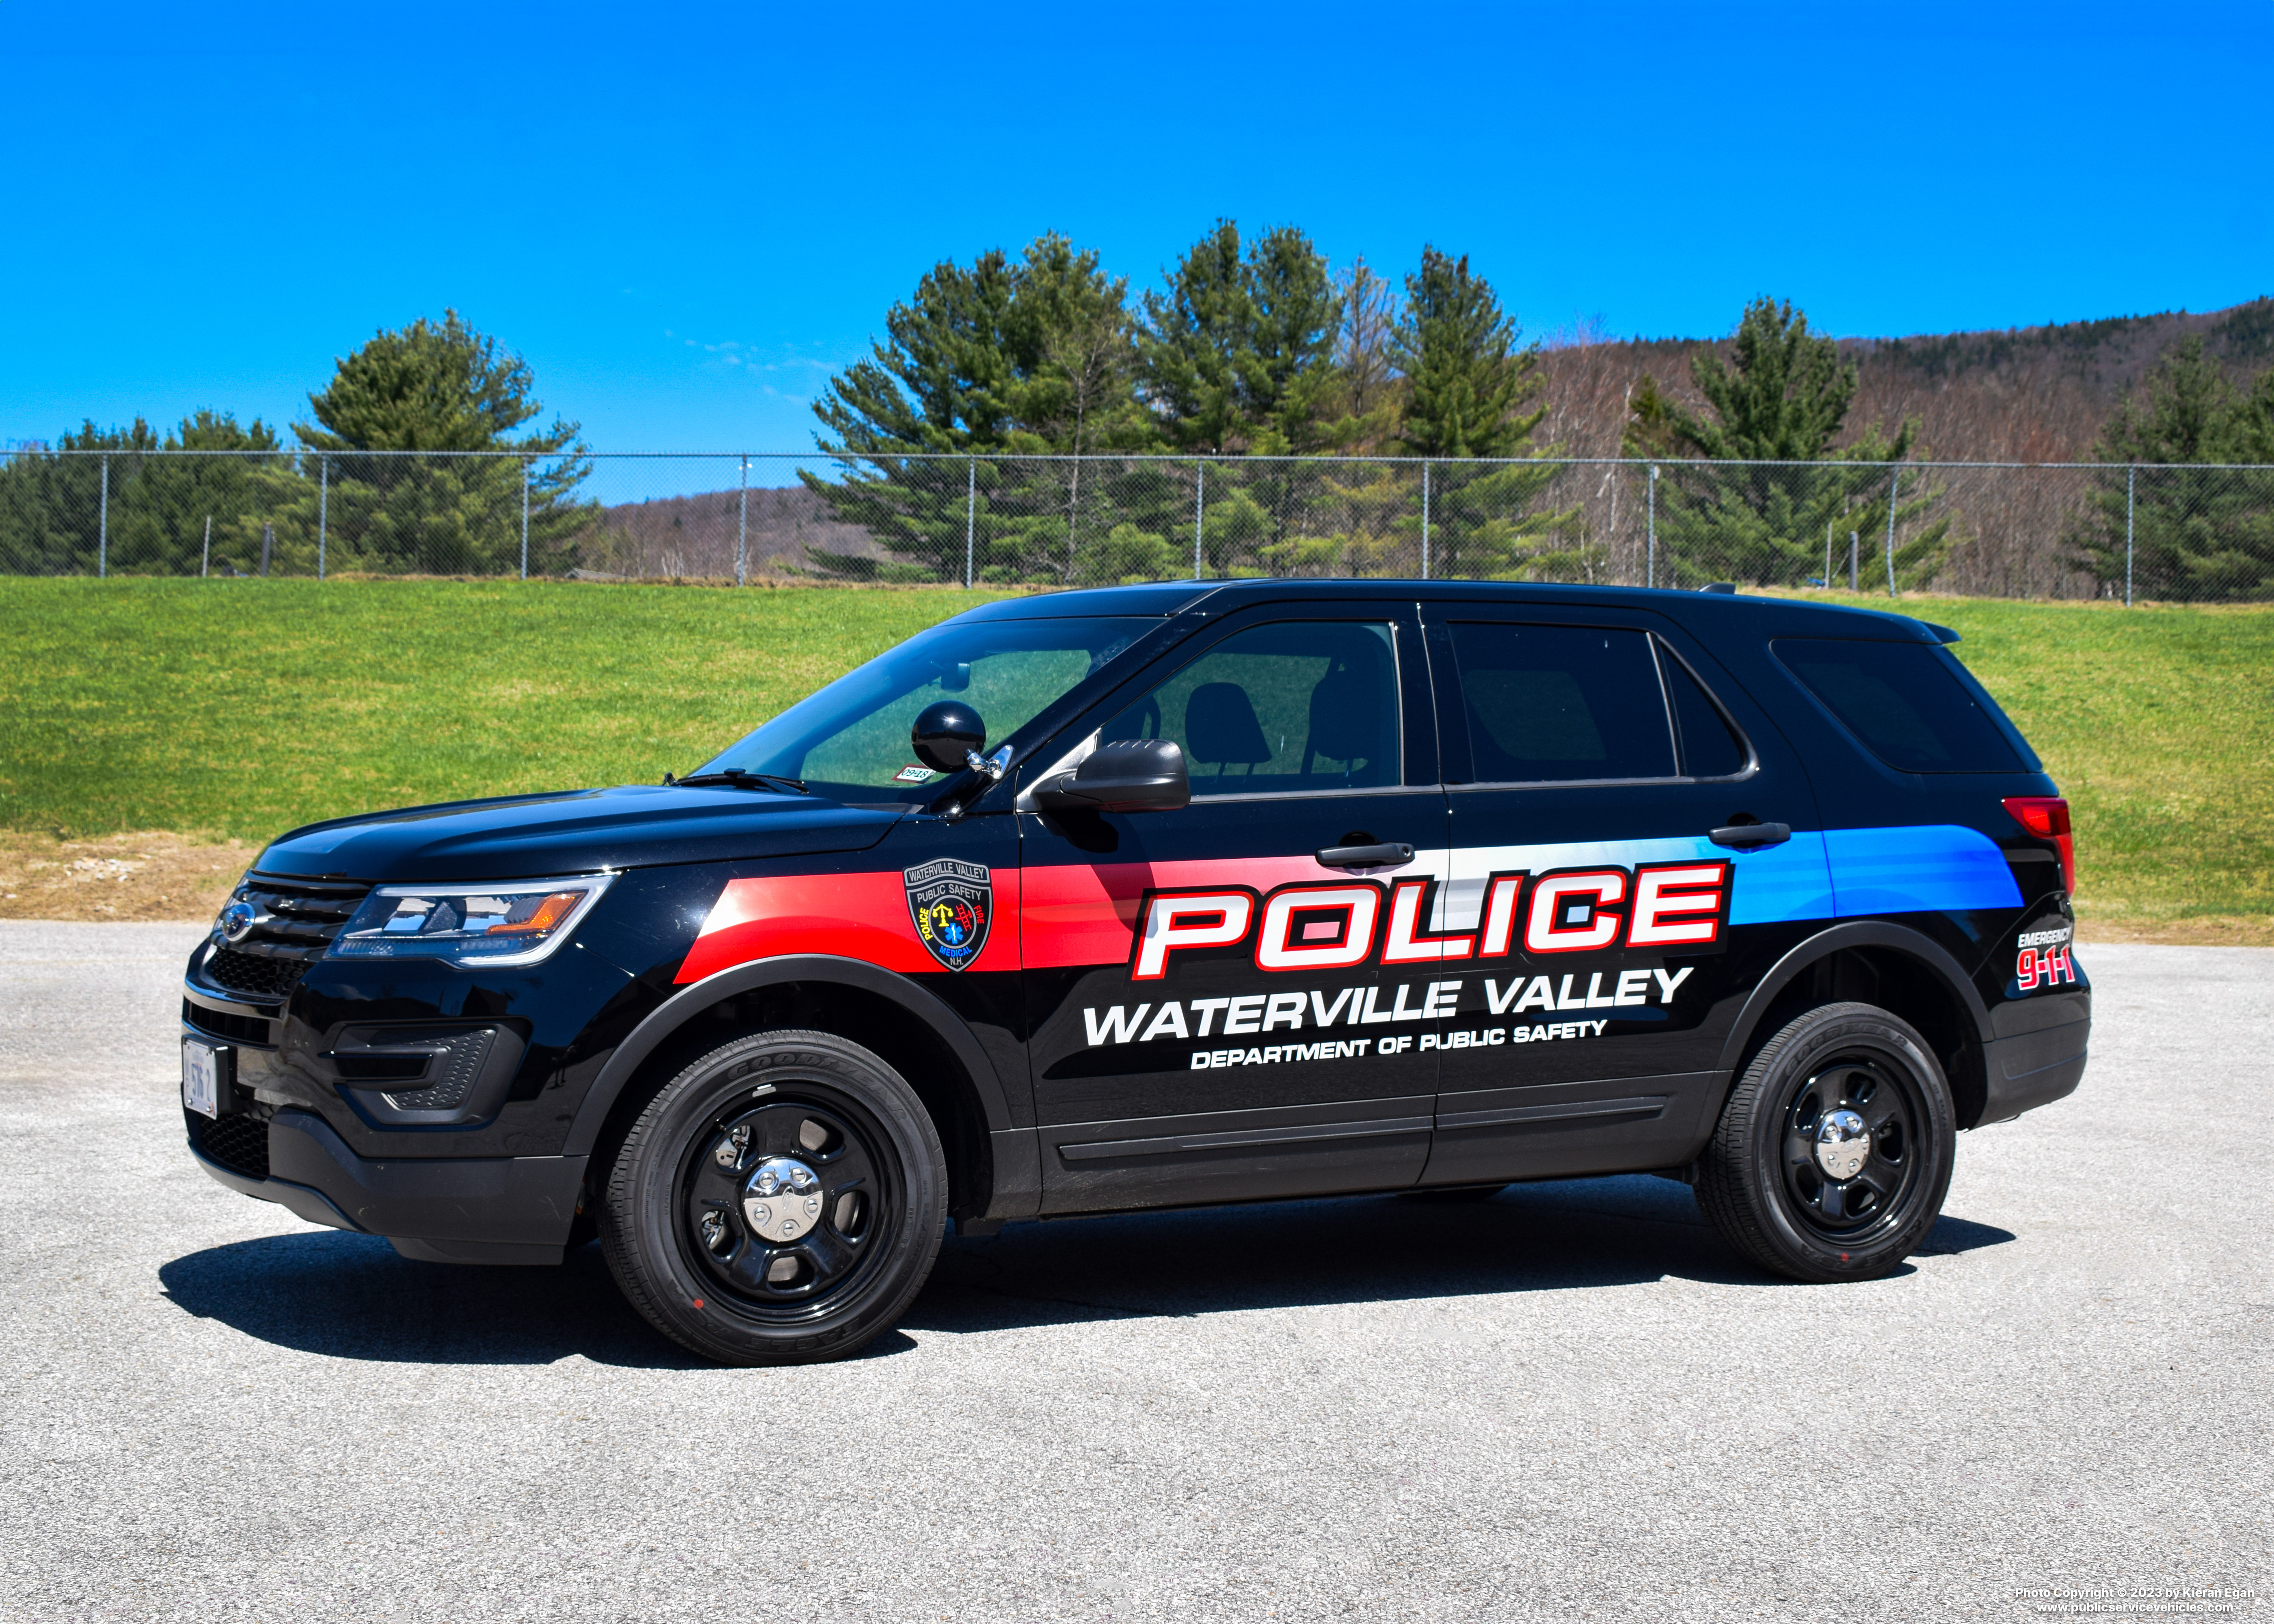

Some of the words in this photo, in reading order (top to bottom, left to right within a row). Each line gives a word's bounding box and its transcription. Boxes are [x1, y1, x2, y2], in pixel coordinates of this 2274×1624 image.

[901, 769, 929, 778] 09-18
[909, 862, 953, 882] WATERVILLE
[955, 863, 984, 879] VALLEY
[917, 885, 945, 903] PUBLIC
[949, 884, 981, 901] SAFETY
[920, 907, 933, 940] POLICE
[973, 905, 984, 924] FIRE
[1132, 864, 1725, 980] POLICE
[2018, 926, 2071, 948] EMERGENCY
[939, 946, 972, 957] MEDICAL
[2017, 944, 2075, 990] 9-1-1
[1084, 980, 1462, 1046] WATERVILLE
[1485, 967, 1694, 1014] VALLEY
[1191, 1039, 1371, 1069] DEPARTMENT
[1378, 1036, 1412, 1054] OF
[1420, 1028, 1505, 1052] PUBLIC
[1514, 1019, 1607, 1043] SAFETY
[728, 1053, 908, 1121] GOODYEAR
